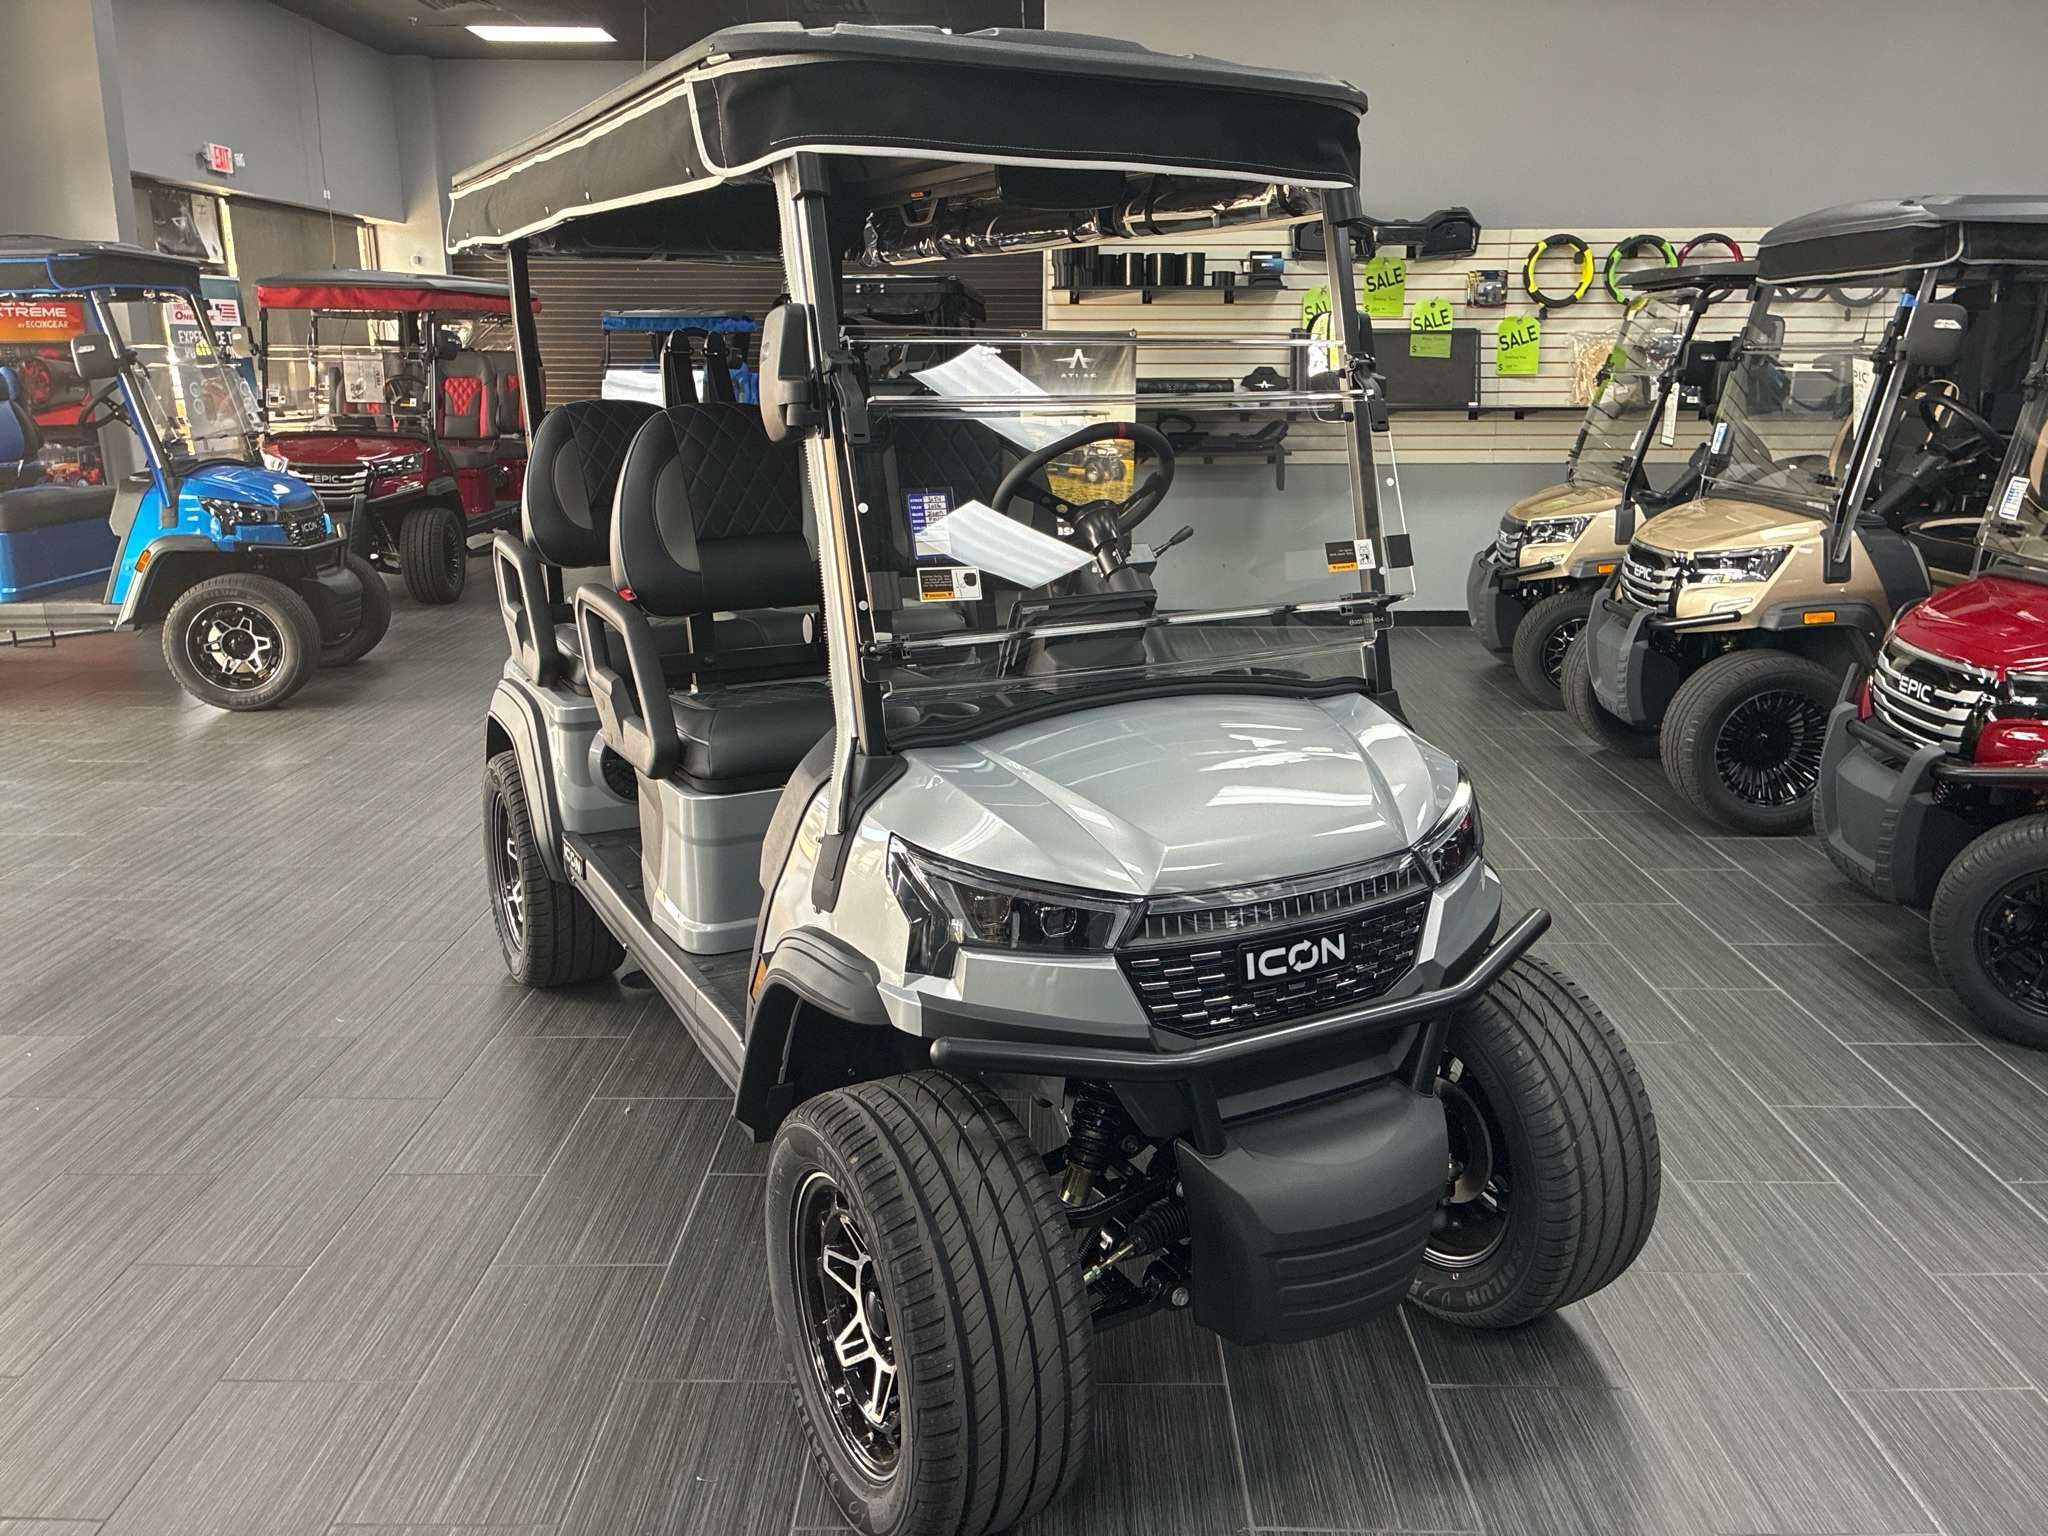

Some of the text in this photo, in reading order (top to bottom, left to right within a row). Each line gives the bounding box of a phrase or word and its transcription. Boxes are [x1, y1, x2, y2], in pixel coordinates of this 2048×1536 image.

[213, 146, 229, 169] EXIT
[1366, 267, 1405, 293] SALE
[1304, 301, 1331, 321] SAL
[1413, 309, 1451, 331] SALE
[1499, 325, 1538, 351] SALE
[314, 475, 339, 483] EPIC
[301, 521, 318, 532] ICON
[1633, 564, 1652, 581] EPIC
[1899, 675, 1931, 703] EPIC
[563, 842, 581, 876] ICON
[1246, 933, 1346, 980] ICON
